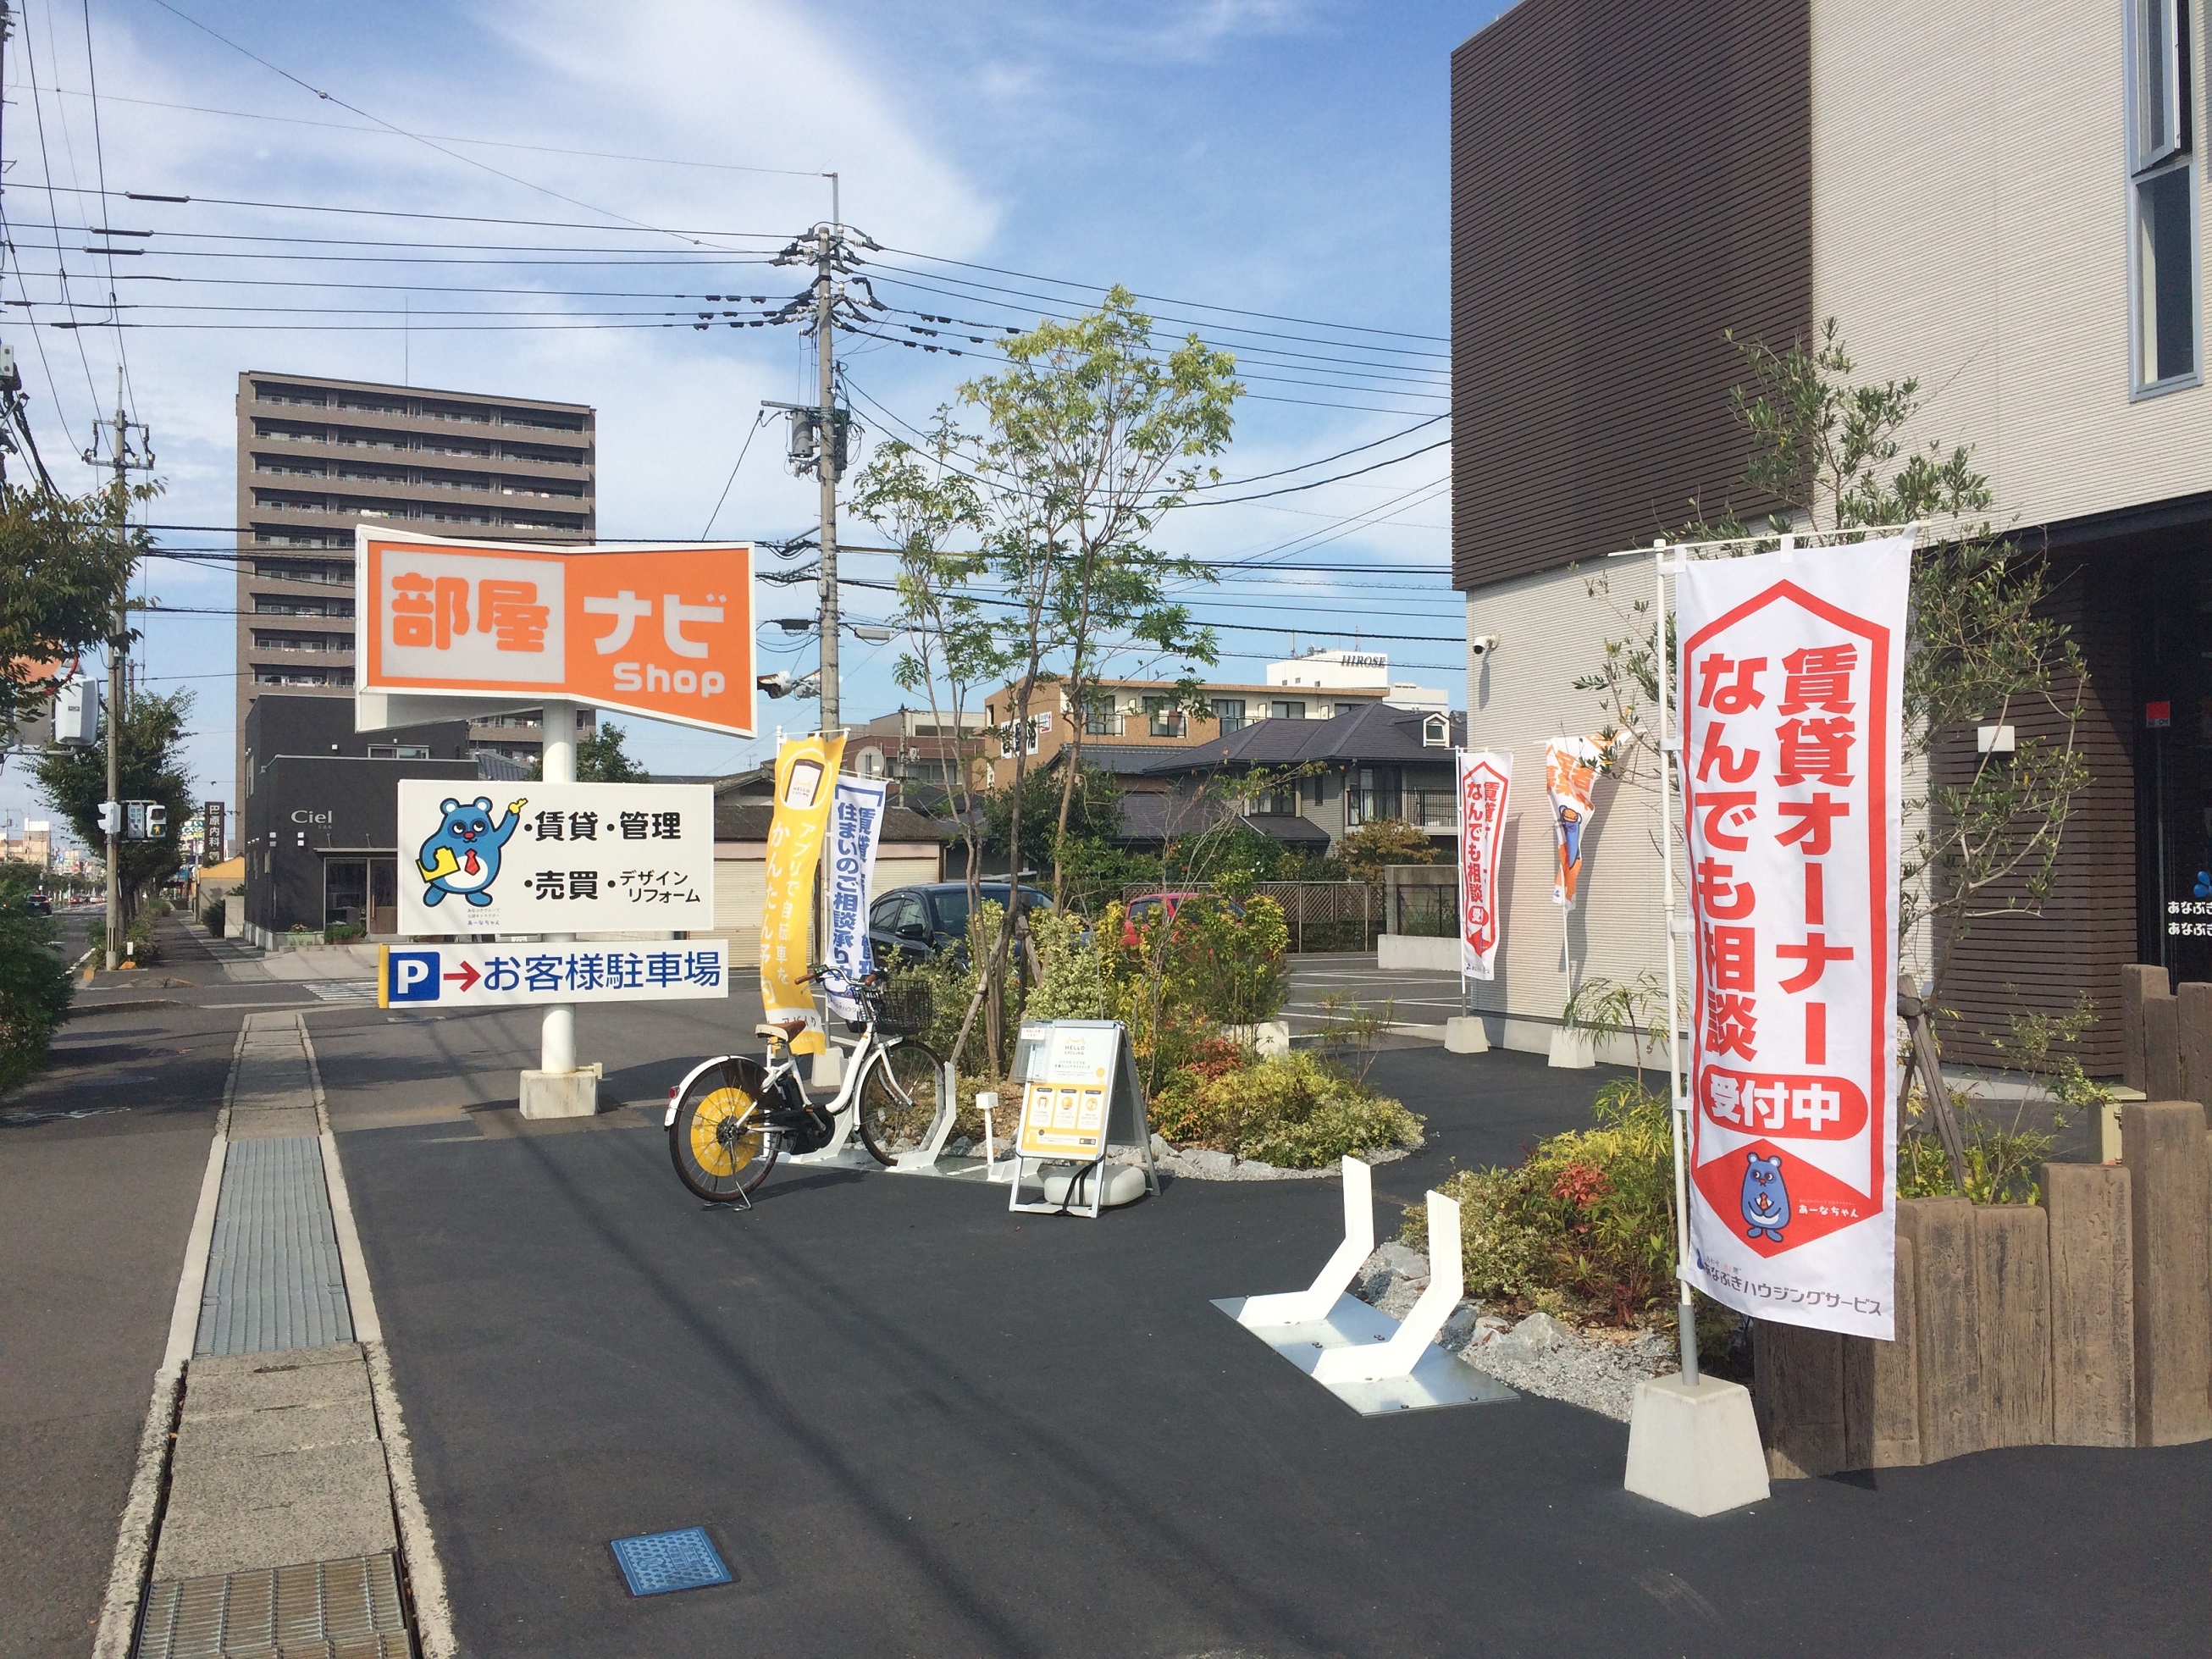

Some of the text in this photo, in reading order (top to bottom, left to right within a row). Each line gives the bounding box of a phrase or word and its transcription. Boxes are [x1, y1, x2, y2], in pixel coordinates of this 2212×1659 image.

[1341, 655, 1386, 667] HIROSE
[612, 662, 726, 698] Shop
[290, 810, 333, 824] Ciel
[1467, 782, 1484, 903] なんでも相談
[1695, 653, 1768, 1061] なんでも相談
[1773, 642, 1858, 1065] 賃貸オーナー
[619, 870, 688, 886] デザイン
[628, 888, 701, 904] リフォーム
[776, 822, 816, 985] アプリで自転車を
[397, 959, 429, 995] P
[484, 950, 721, 993] お客様駐車場
[1709, 1071, 1840, 1131] 受付中
[1798, 1204, 1859, 1219] あーなちゃん
